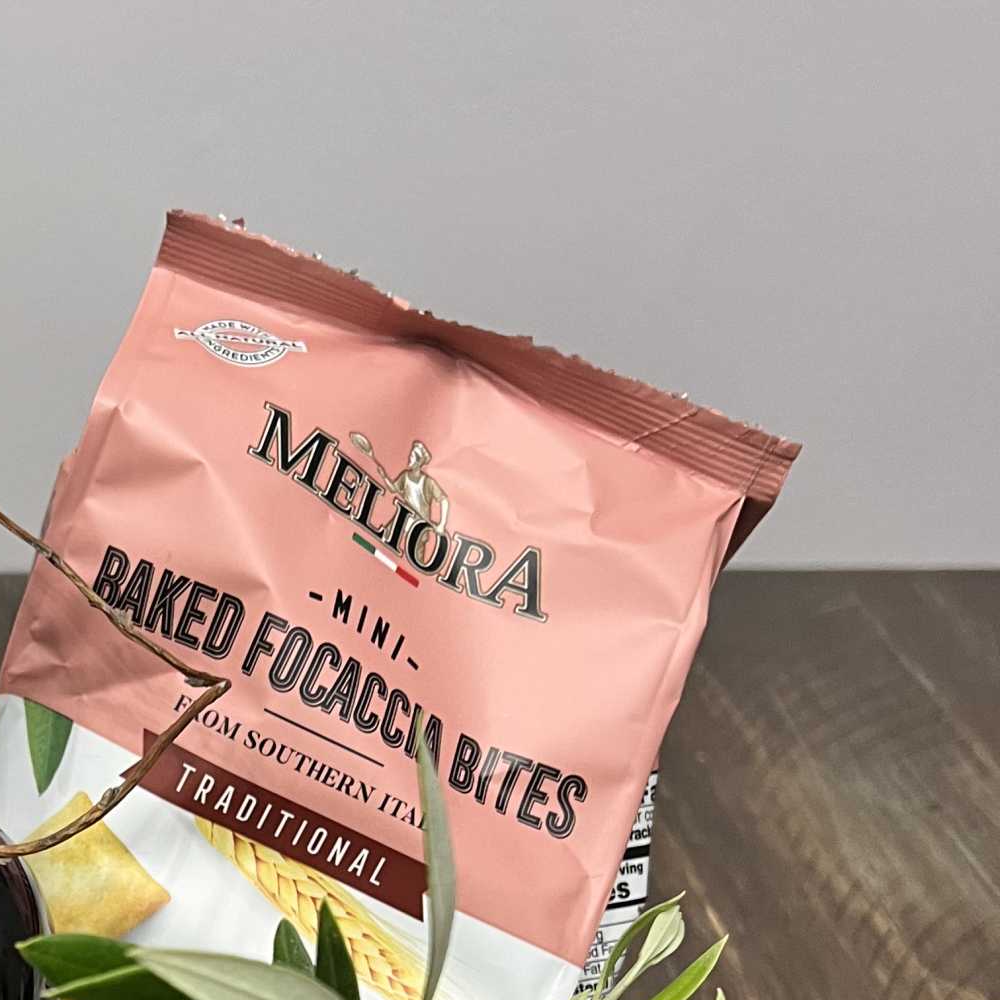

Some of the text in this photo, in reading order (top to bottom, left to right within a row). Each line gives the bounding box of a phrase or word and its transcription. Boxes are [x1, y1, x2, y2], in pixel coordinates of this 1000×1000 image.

[247, 401, 547, 623] MELIORA
[93, 545, 588, 840] BAKED FOCACCIA BITES
[173, 694, 243, 741] FOM
[243, 729, 377, 803] SOUTHERN
[175, 762, 387, 886] TRADITIONAL
